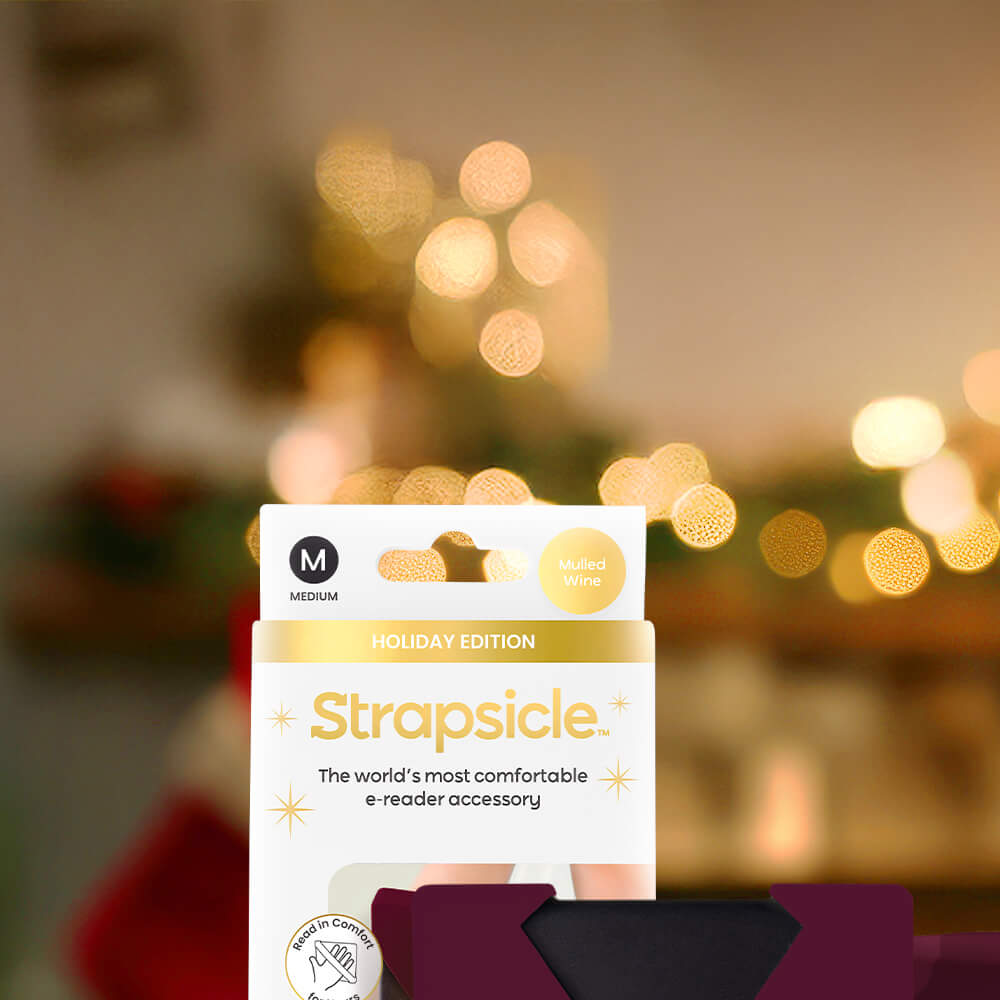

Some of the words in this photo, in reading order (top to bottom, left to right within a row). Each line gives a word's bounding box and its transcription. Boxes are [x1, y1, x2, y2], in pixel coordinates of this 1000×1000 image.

[301, 549, 326, 571] M
[559, 558, 606, 572] Mulled
[564, 574, 602, 588] Wine
[290, 591, 339, 602] MEDIUM
[372, 634, 455, 650] HOLIDAY
[461, 634, 536, 650] EDITION
[318, 768, 350, 783] The
[425, 769, 470, 783] most
[474, 767, 588, 783] comfortable
[365, 791, 445, 806] e-reader
[448, 794, 541, 810] accessory
[292, 923, 317, 951] Read
[317, 919, 330, 930] in
[332, 918, 375, 950] Comfort
